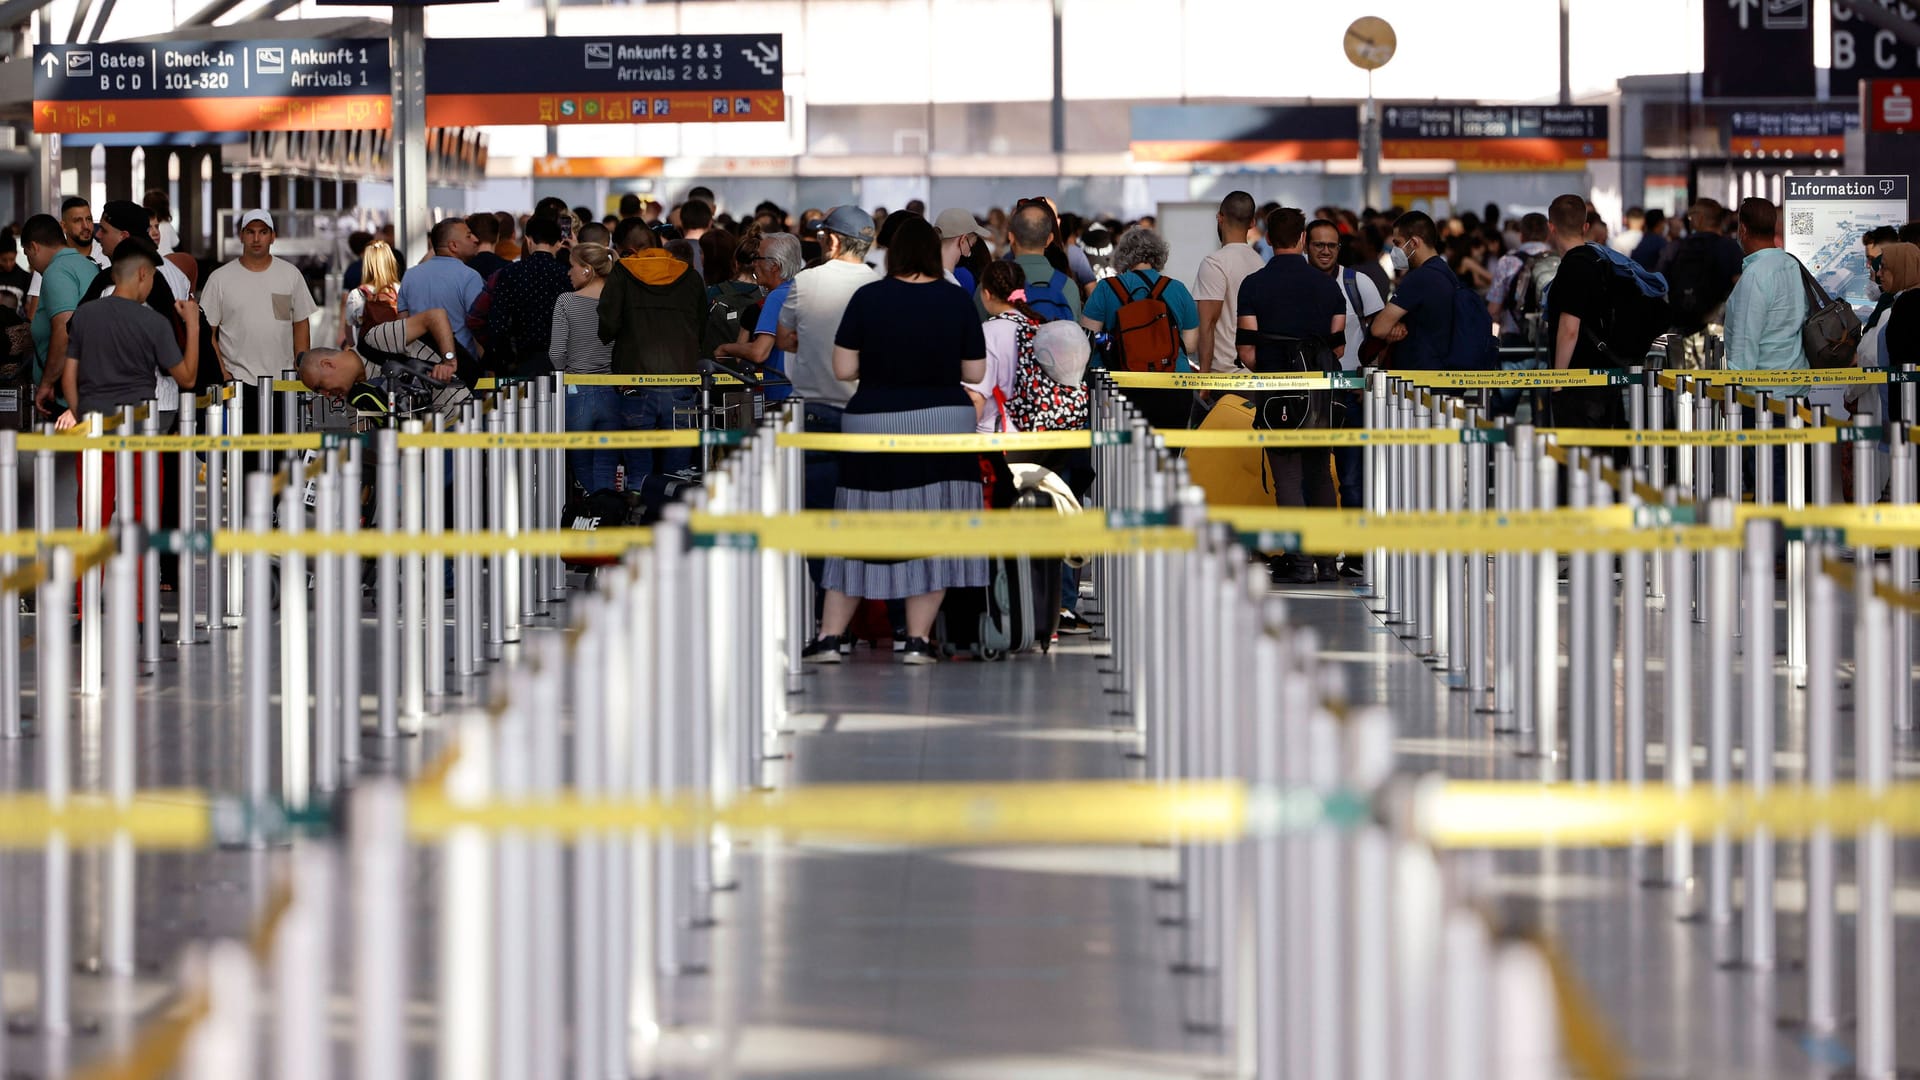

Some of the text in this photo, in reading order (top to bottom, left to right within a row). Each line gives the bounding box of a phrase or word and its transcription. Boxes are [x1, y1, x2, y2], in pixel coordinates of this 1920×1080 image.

[164, 50, 235, 67] Check-in
[290, 47, 368, 65] Ankunft 1
[617, 43, 723, 60] Ankunft 2 & 3
[1833, 31, 1896, 69] B C
[100, 52, 145, 68] Gates
[164, 72, 229, 89] 101-320
[291, 69, 368, 87] Arrivals 1
[617, 64, 723, 81] Arrivals 2 & 3
[100, 74, 142, 90] B C D
[1790, 181, 1875, 195] Information
[571, 516, 601, 531] NIKE
